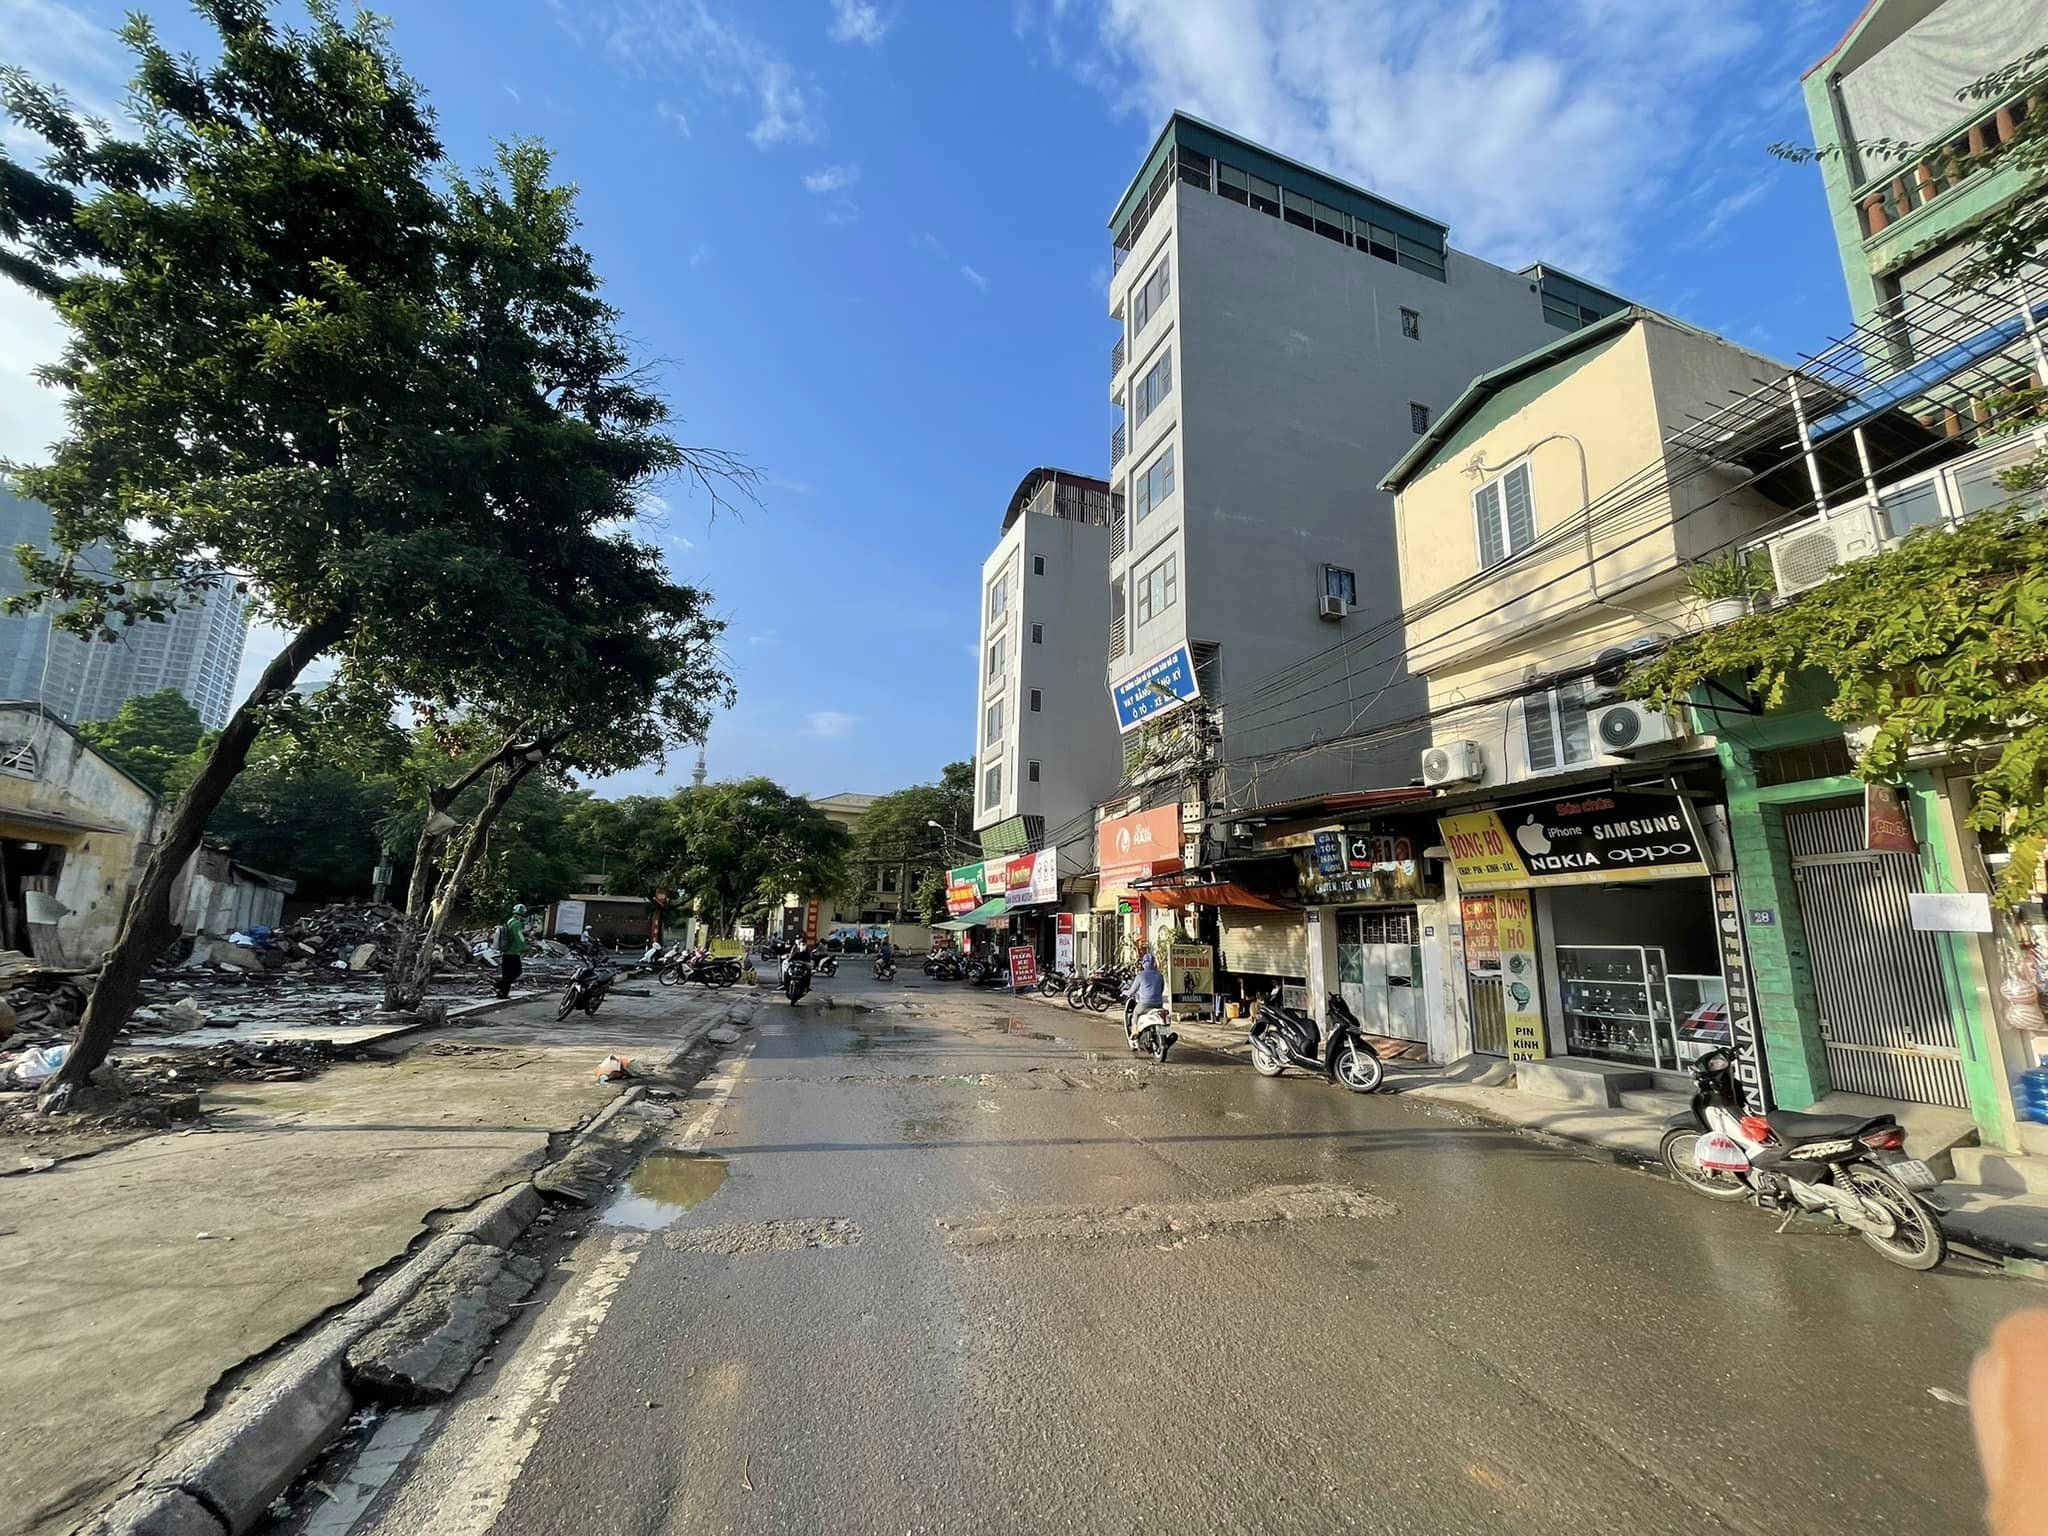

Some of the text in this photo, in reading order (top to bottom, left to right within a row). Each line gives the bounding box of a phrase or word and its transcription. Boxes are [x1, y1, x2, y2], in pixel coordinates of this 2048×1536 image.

[1547, 814, 1681, 840] iPhone SAMSUNG
[1530, 852, 1600, 871] NOKIA
[1754, 911, 1769, 923] 28
[1515, 1027, 1534, 1036] PIN
[1735, 1015, 1761, 1106] NOKIA
